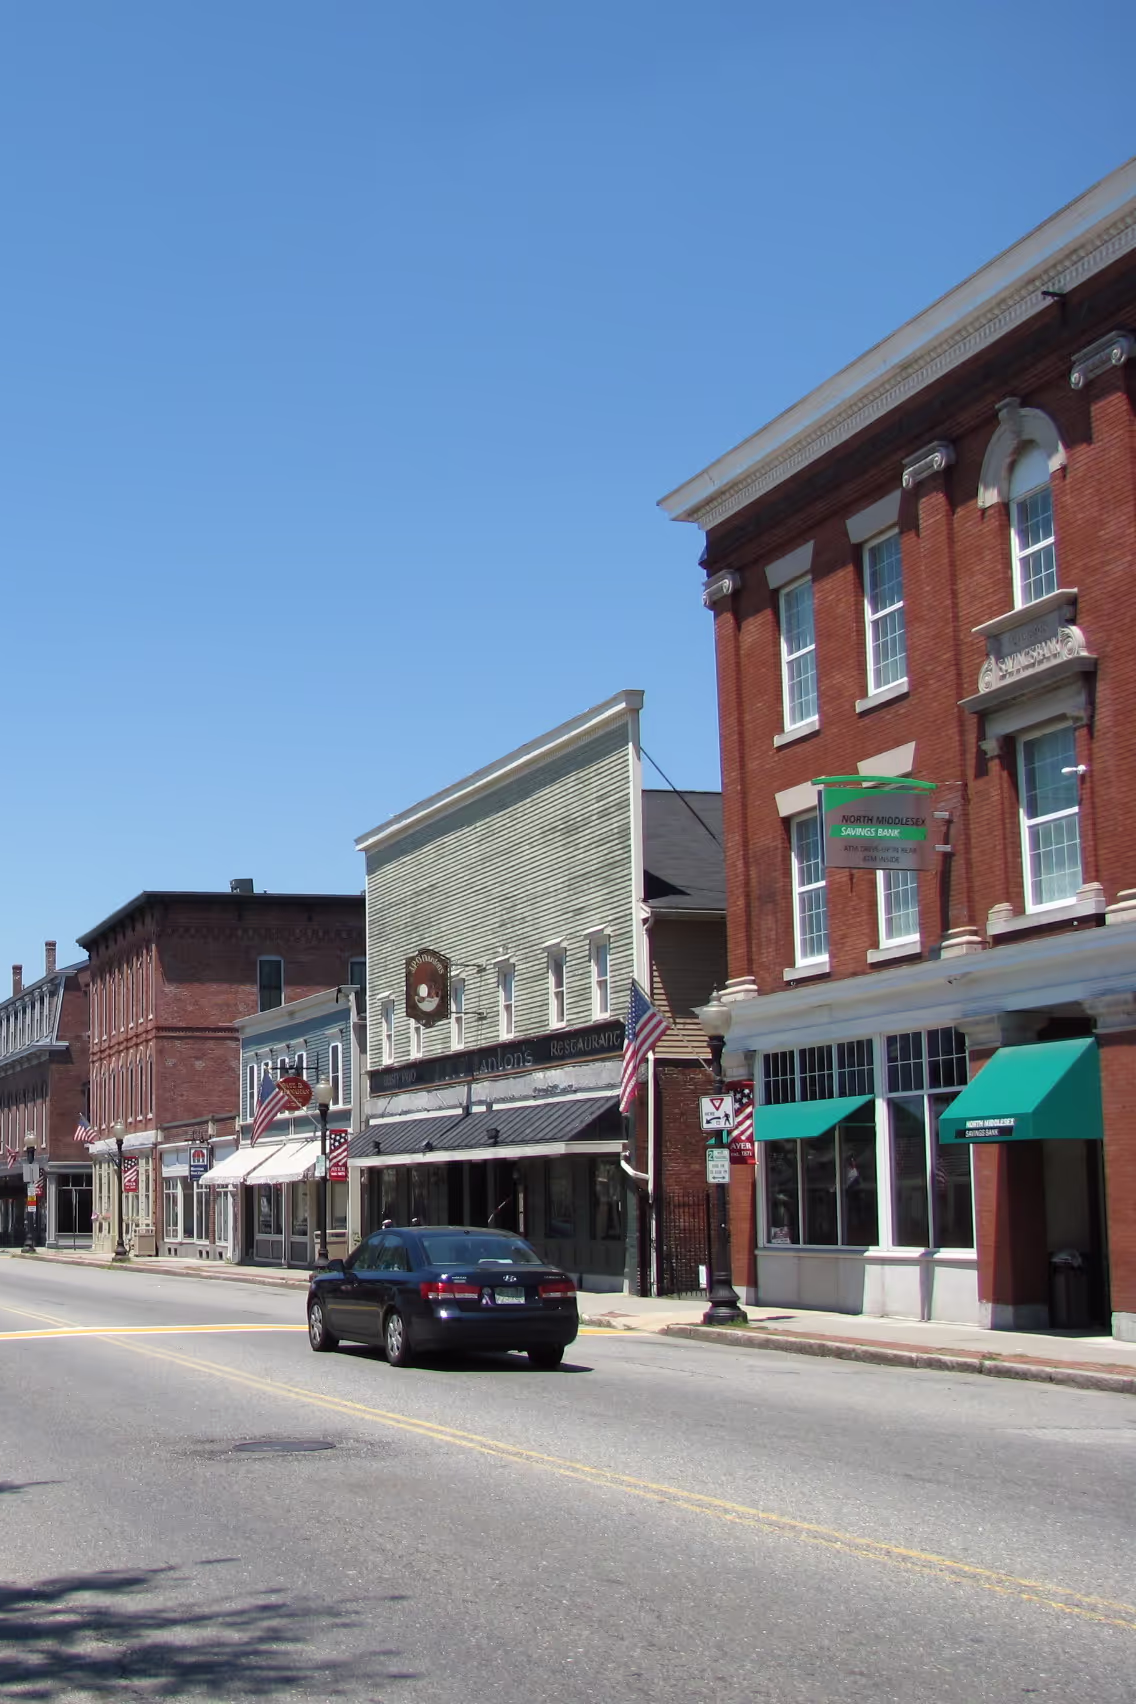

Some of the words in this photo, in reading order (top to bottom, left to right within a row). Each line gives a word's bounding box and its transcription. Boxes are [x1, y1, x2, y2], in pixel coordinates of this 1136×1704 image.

[997, 644, 1036, 676] SAVINGS
[1035, 636, 1061, 660] BANK
[841, 814, 874, 825] NORTH
[876, 815, 927, 827] MIDDLESEX
[841, 826, 876, 837] SAVINGS
[877, 827, 901, 837] BANK
[965, 1130, 985, 1138] SAVINGS
[986, 1129, 999, 1137] BANK
[730, 1142, 752, 1150] AYER
